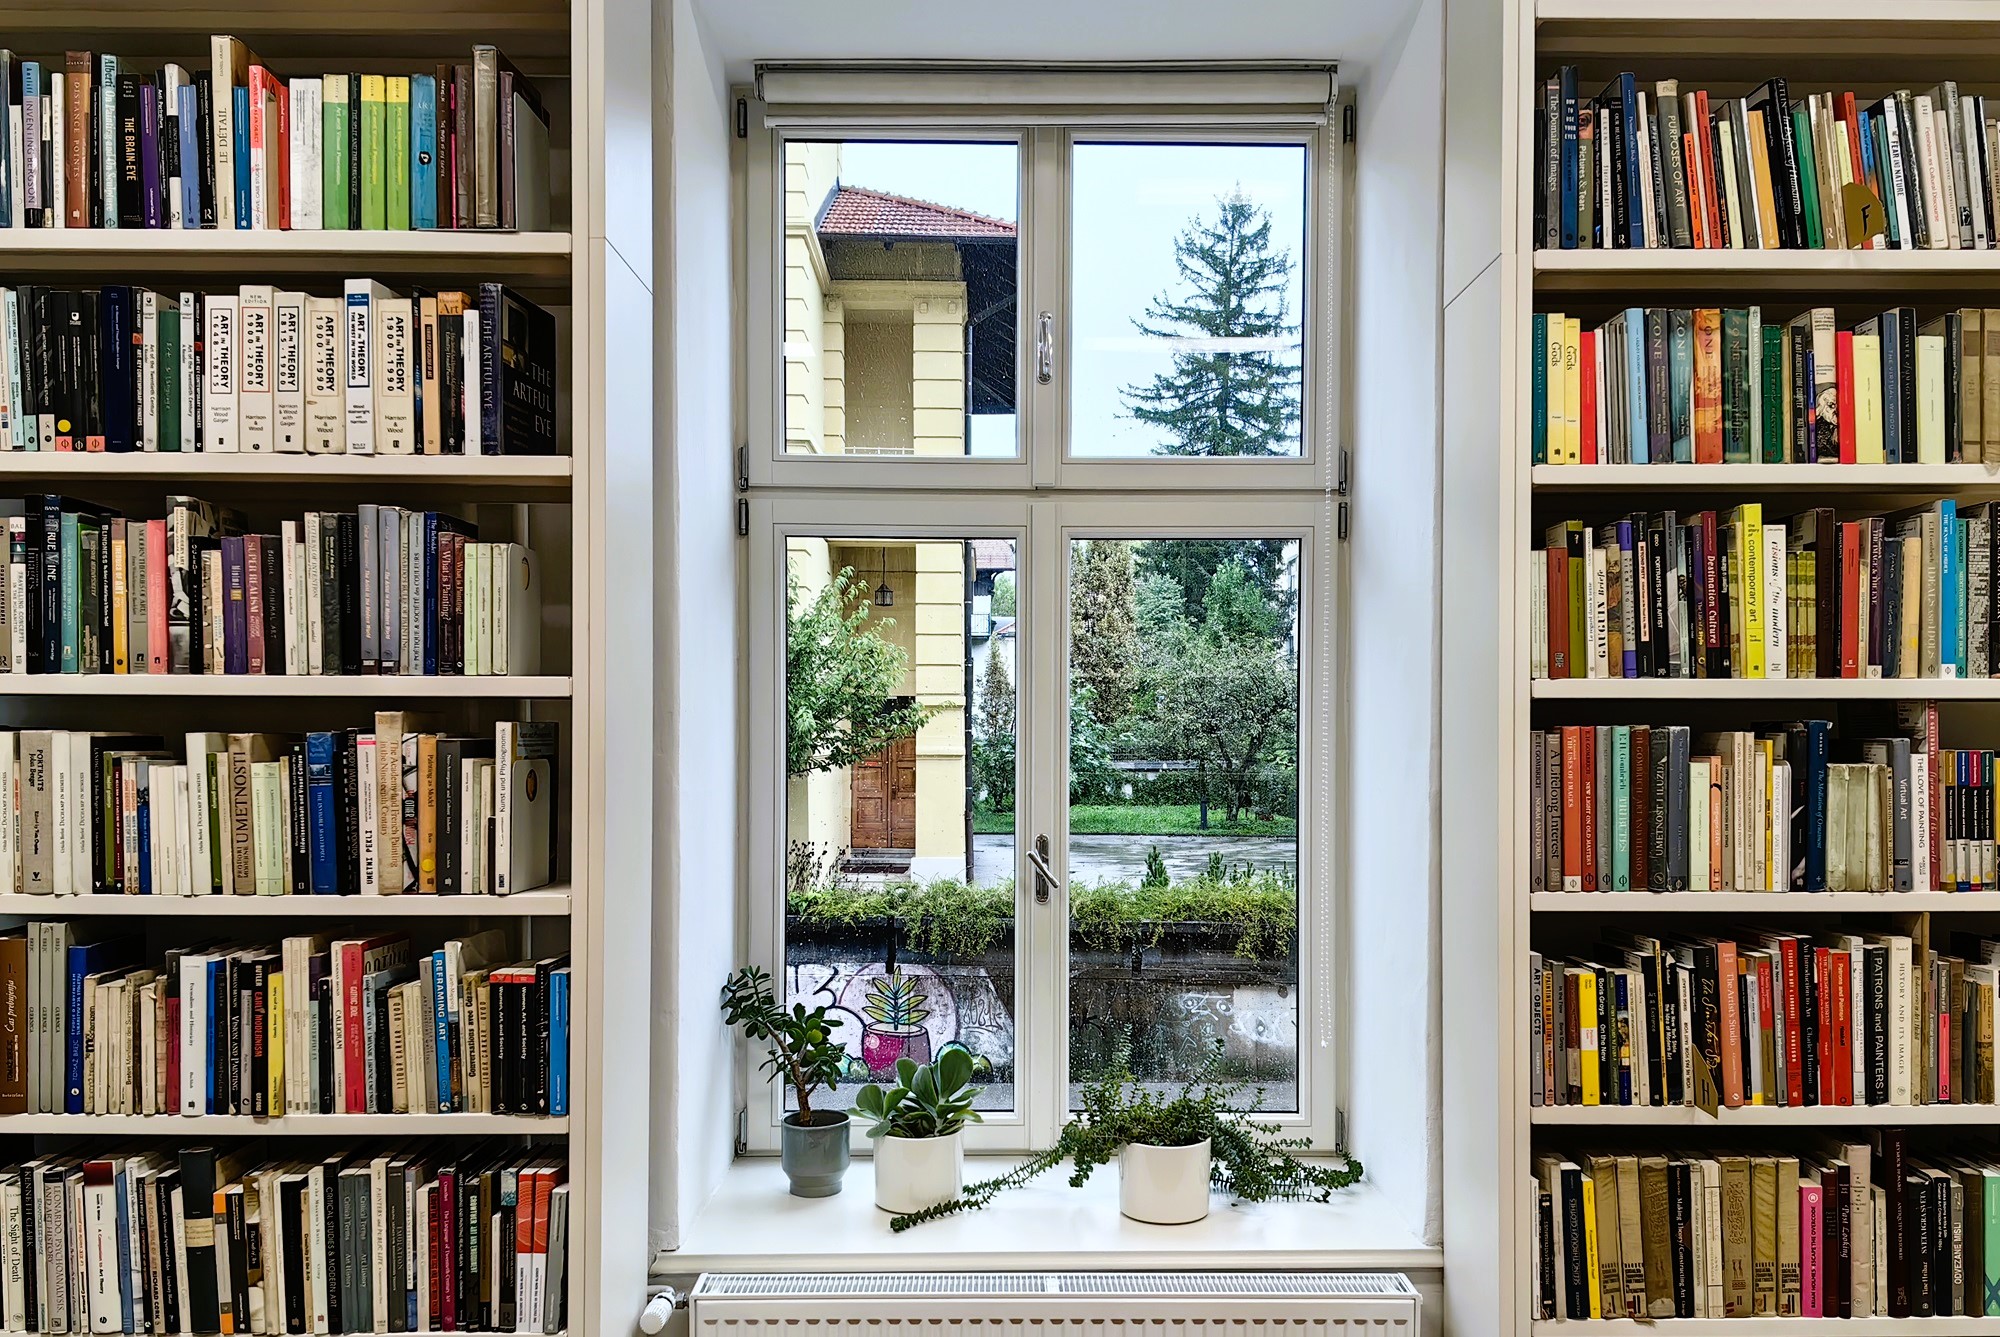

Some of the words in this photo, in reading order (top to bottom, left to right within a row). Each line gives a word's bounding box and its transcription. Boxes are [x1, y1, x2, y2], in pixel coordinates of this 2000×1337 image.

[104, 58, 115, 87] Alberti
[106, 90, 116, 101] On
[26, 100, 35, 155] INVENTING
[104, 104, 116, 140] Painting
[124, 117, 134, 133] THE
[218, 108, 227, 147] DÉTAIL
[1550, 113, 1558, 146] Domain
[106, 141, 116, 156] and
[1551, 149, 1558, 158] of
[1668, 116, 1680, 167] PURPOSES
[1891, 141, 1901, 158] FEAR
[106, 157, 116, 170] On
[125, 136, 136, 181] BRAIN-EYE
[219, 151, 228, 163] LE
[1578, 145, 1586, 179] Pictures
[27, 158, 35, 203] BERGSON
[1549, 161, 1558, 191] Images
[1579, 181, 1586, 189] &
[1673, 171, 1682, 185] OF
[1894, 170, 1904, 196] NATURE
[105, 172, 116, 211] Sculpture
[1674, 188, 1685, 208] ART
[1861, 204, 1871, 236] F
[255, 313, 263, 334] ART
[326, 316, 334, 338] ART
[357, 313, 365, 333] ART
[396, 316, 404, 338] ART
[483, 318, 492, 341] THE
[1676, 315, 1684, 361] ZONE
[220, 344, 228, 388] THEORY
[255, 344, 263, 386] THEORY
[483, 344, 492, 386] ARTFUL
[1551, 342, 1561, 366] Gods
[1566, 346, 1575, 370] Gods
[326, 347, 334, 391] THEORY
[396, 347, 404, 392] THEORY
[483, 391, 492, 409] EYE
[248, 542, 257, 572] SUPER
[442, 551, 450, 573] What
[1707, 555, 1716, 607] Destination
[1747, 540, 1758, 606] contemporary
[248, 574, 258, 613] REALISM
[440, 583, 451, 620] Painting?
[1708, 610, 1717, 643] Culture
[1750, 609, 1758, 622] art
[390, 741, 398, 756] The
[1551, 750, 1559, 760] A
[28, 769, 36, 787] Berger
[380, 764, 388, 804] Nineteenth
[389, 758, 399, 792] Academy
[1547, 763, 1561, 812] Lifelong
[233, 752, 249, 843] UMETNOSTI
[390, 793, 398, 807] and
[1918, 797, 1924, 807] OF
[380, 806, 388, 836] Century
[391, 809, 399, 834] French
[1619, 797, 1627, 852] TRIBUTES
[1900, 807, 1908, 819] Art
[1551, 815, 1560, 859] Interest
[390, 837, 399, 867] Painting
[436, 959, 444, 1017] REFRAMING
[1874, 958, 1883, 1009] PATRONS
[254, 992, 262, 1013] EARLY
[1597, 996, 1606, 1015] Groys
[231, 1015, 239, 1039] VISION
[438, 1022, 446, 1041] ART
[1600, 1024, 1606, 1034] On
[1875, 1013, 1883, 1032] and
[231, 1058, 239, 1091] PAINTING
[1875, 1036, 1884, 1089] PAINTERS
[10, 1206, 19, 1222] The
[326, 1187, 334, 1218] CRITICAL
[1676, 1198, 1684, 1220] Making
[1841, 1205, 1850, 1225] Past
[9, 1224, 19, 1245] Sight
[1841, 1227, 1849, 1258] Looking
[1953, 1222, 1961, 1242] MISLI
[11, 1247, 19, 1256] of
[1954, 1244, 1962, 1284] ODVEZANE
[11, 1259, 20, 1282] Death
